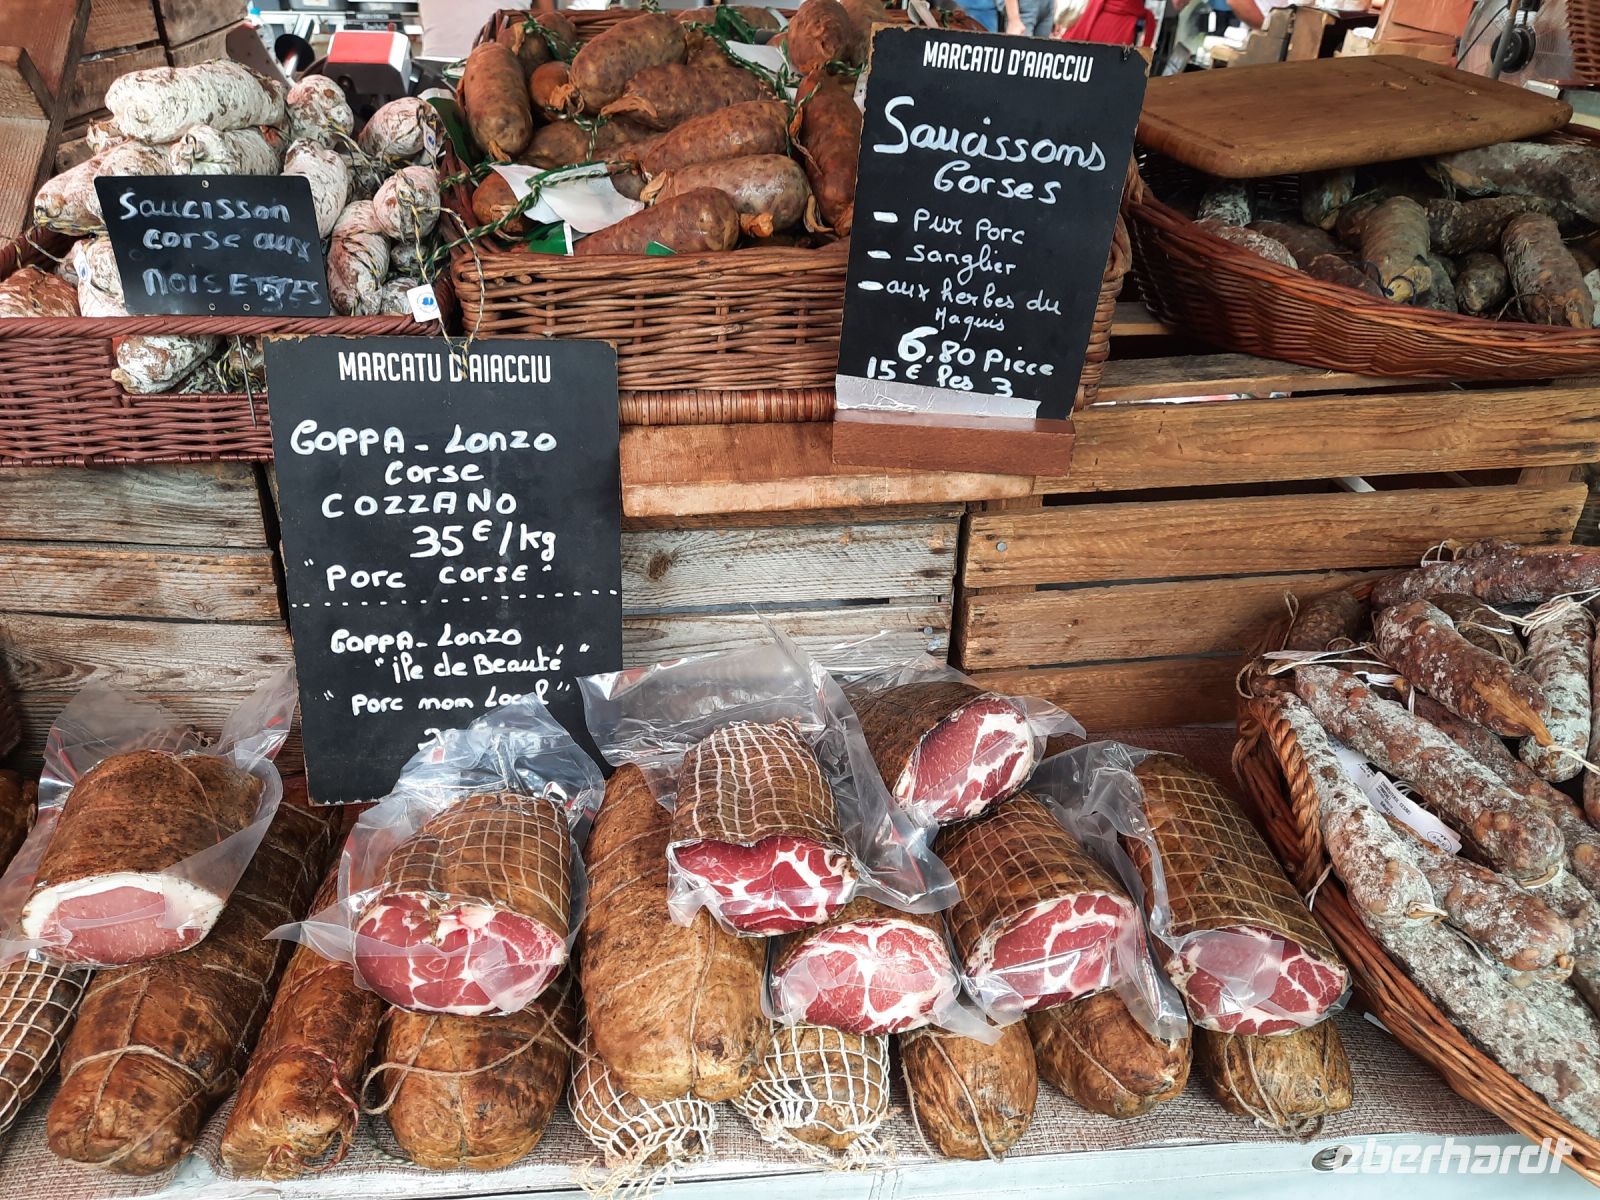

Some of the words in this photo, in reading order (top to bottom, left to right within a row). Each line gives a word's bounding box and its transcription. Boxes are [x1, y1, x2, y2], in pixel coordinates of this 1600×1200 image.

[922, 40, 1005, 74] MARCATU
[1007, 48, 1094, 83] D'AIACCIU
[119, 191, 291, 223] Saucisson
[1026, 289, 1062, 315] du
[337, 351, 442, 382] MARCATU
[448, 353, 552, 384] DAIACCIU
[990, 377, 1014, 398] 3
[433, 651, 469, 677] de
